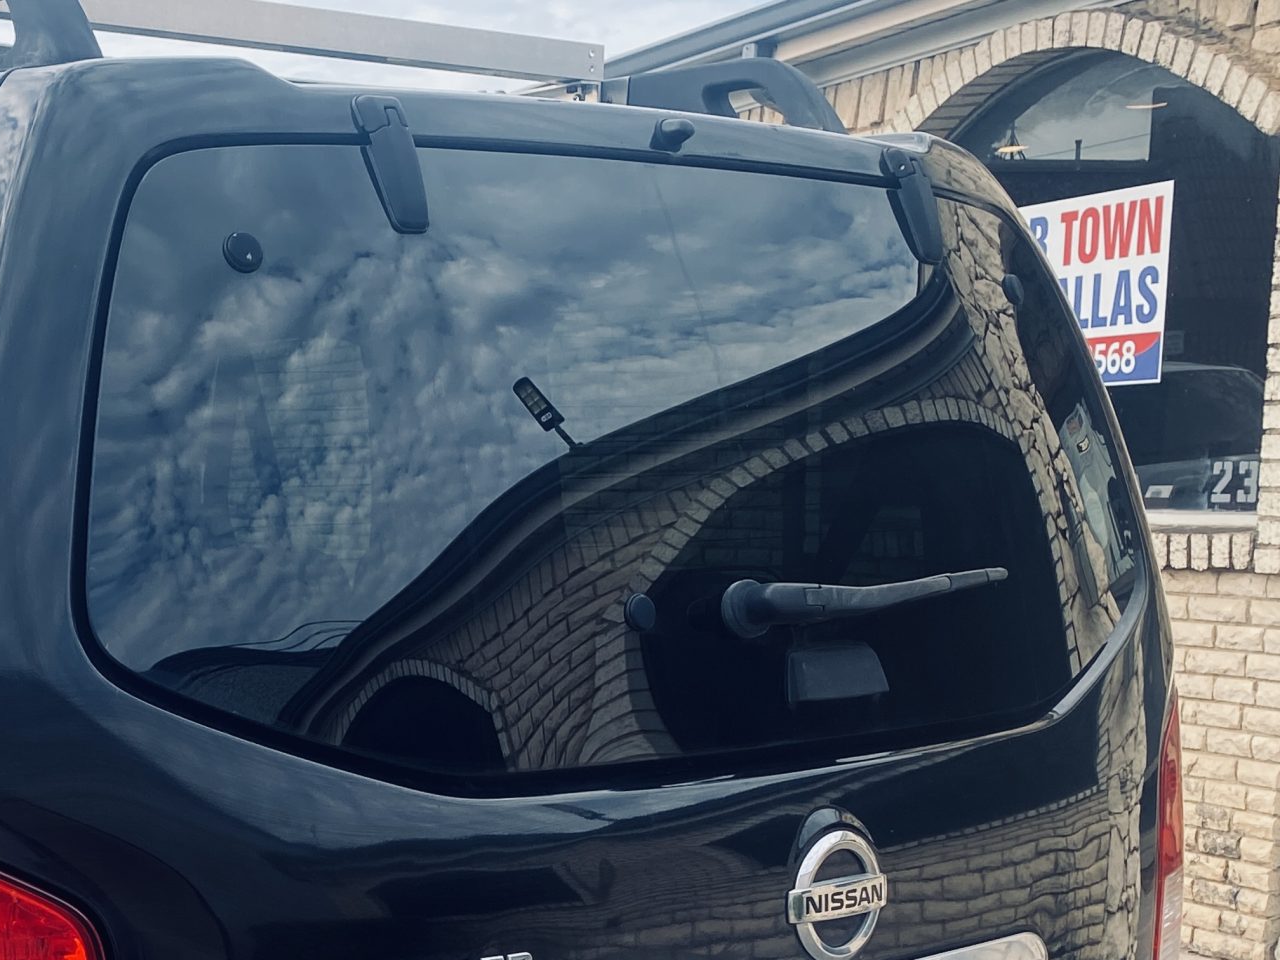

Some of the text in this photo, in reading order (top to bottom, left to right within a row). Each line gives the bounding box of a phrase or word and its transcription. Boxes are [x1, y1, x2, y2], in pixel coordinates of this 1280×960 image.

[1060, 195, 1165, 266] TOWN
[1058, 265, 1160, 330] LLAS
[1088, 340, 1136, 375] 568
[1210, 460, 1258, 503] 23
[805, 882, 883, 915] NISSAN
